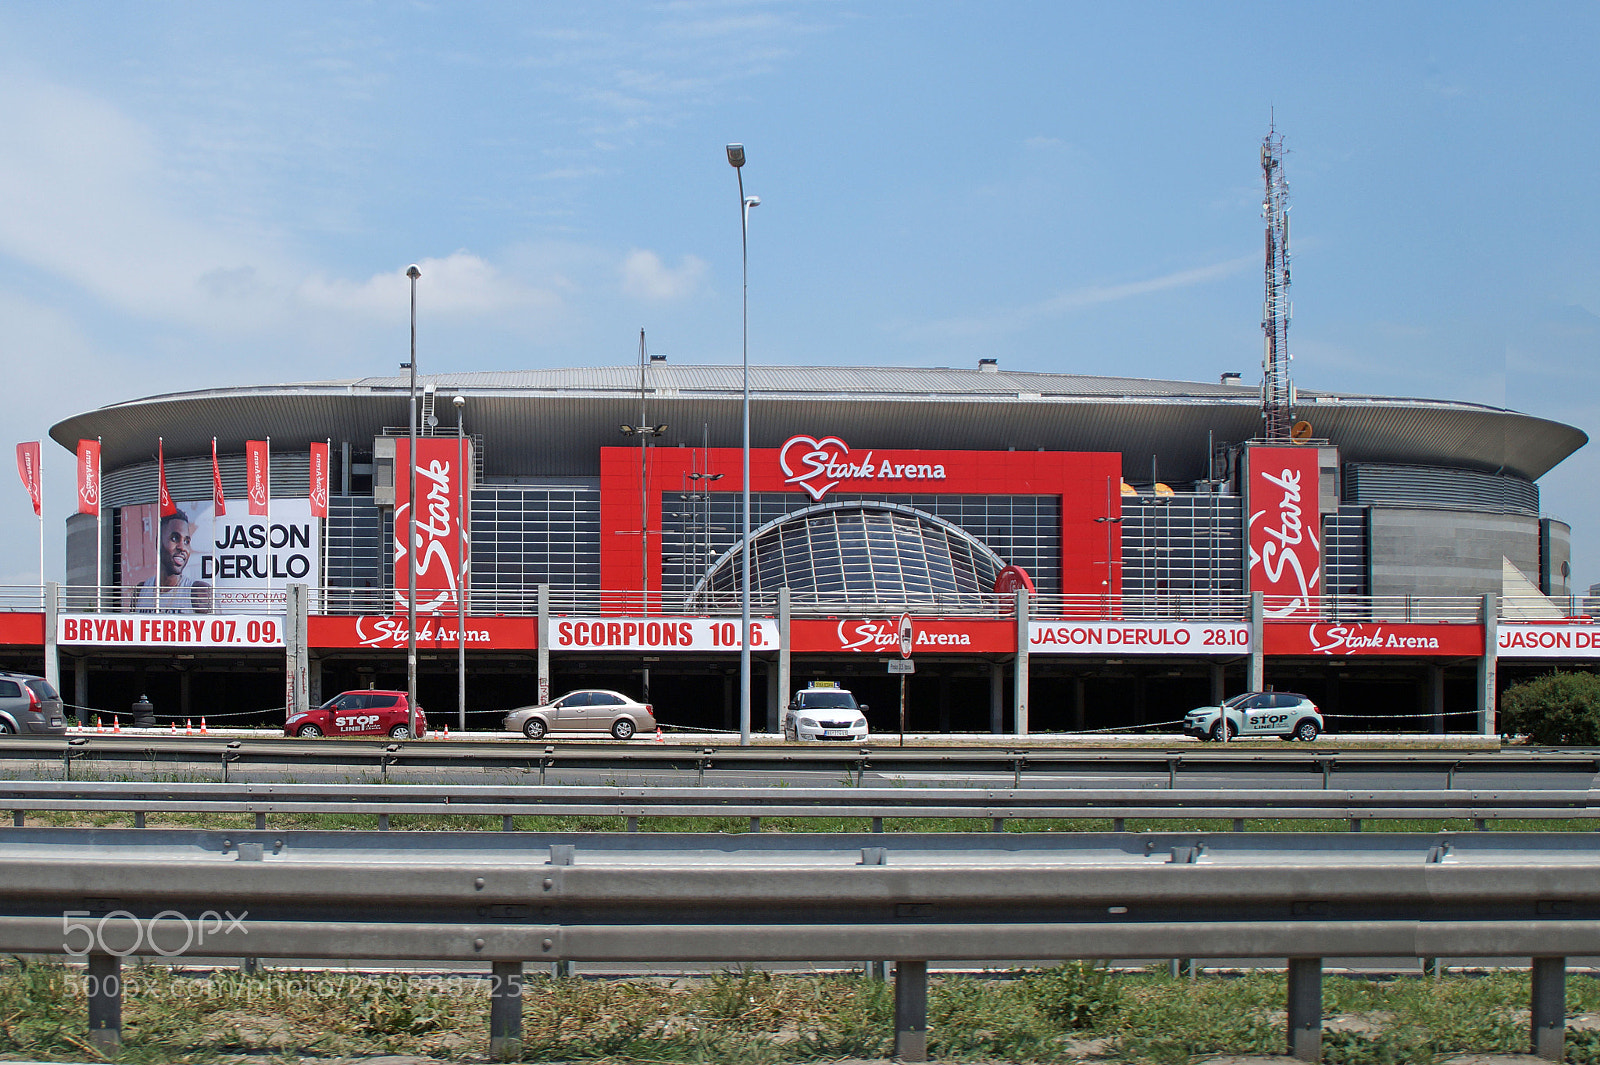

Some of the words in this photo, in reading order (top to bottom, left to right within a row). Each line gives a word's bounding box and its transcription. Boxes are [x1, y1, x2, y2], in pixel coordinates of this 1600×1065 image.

[877, 459, 947, 480] Arena
[215, 524, 309, 549] JASON
[201, 554, 310, 579] DERULO
[64, 618, 134, 642] BRYAN
[139, 620, 206, 642] FERRY
[210, 620, 241, 643] 07.
[246, 620, 282, 643] 09.
[558, 621, 693, 647] SCORPIONS
[915, 630, 971, 645] Arena
[1030, 628, 1102, 645] JASON
[1107, 629, 1191, 646] DERULO
[1203, 629, 1249, 646] 28.10
[1385, 633, 1440, 649] Arena
[1498, 632, 1571, 649] JASON
[335, 715, 380, 728] STOP
[1249, 714, 1288, 726] STOP
